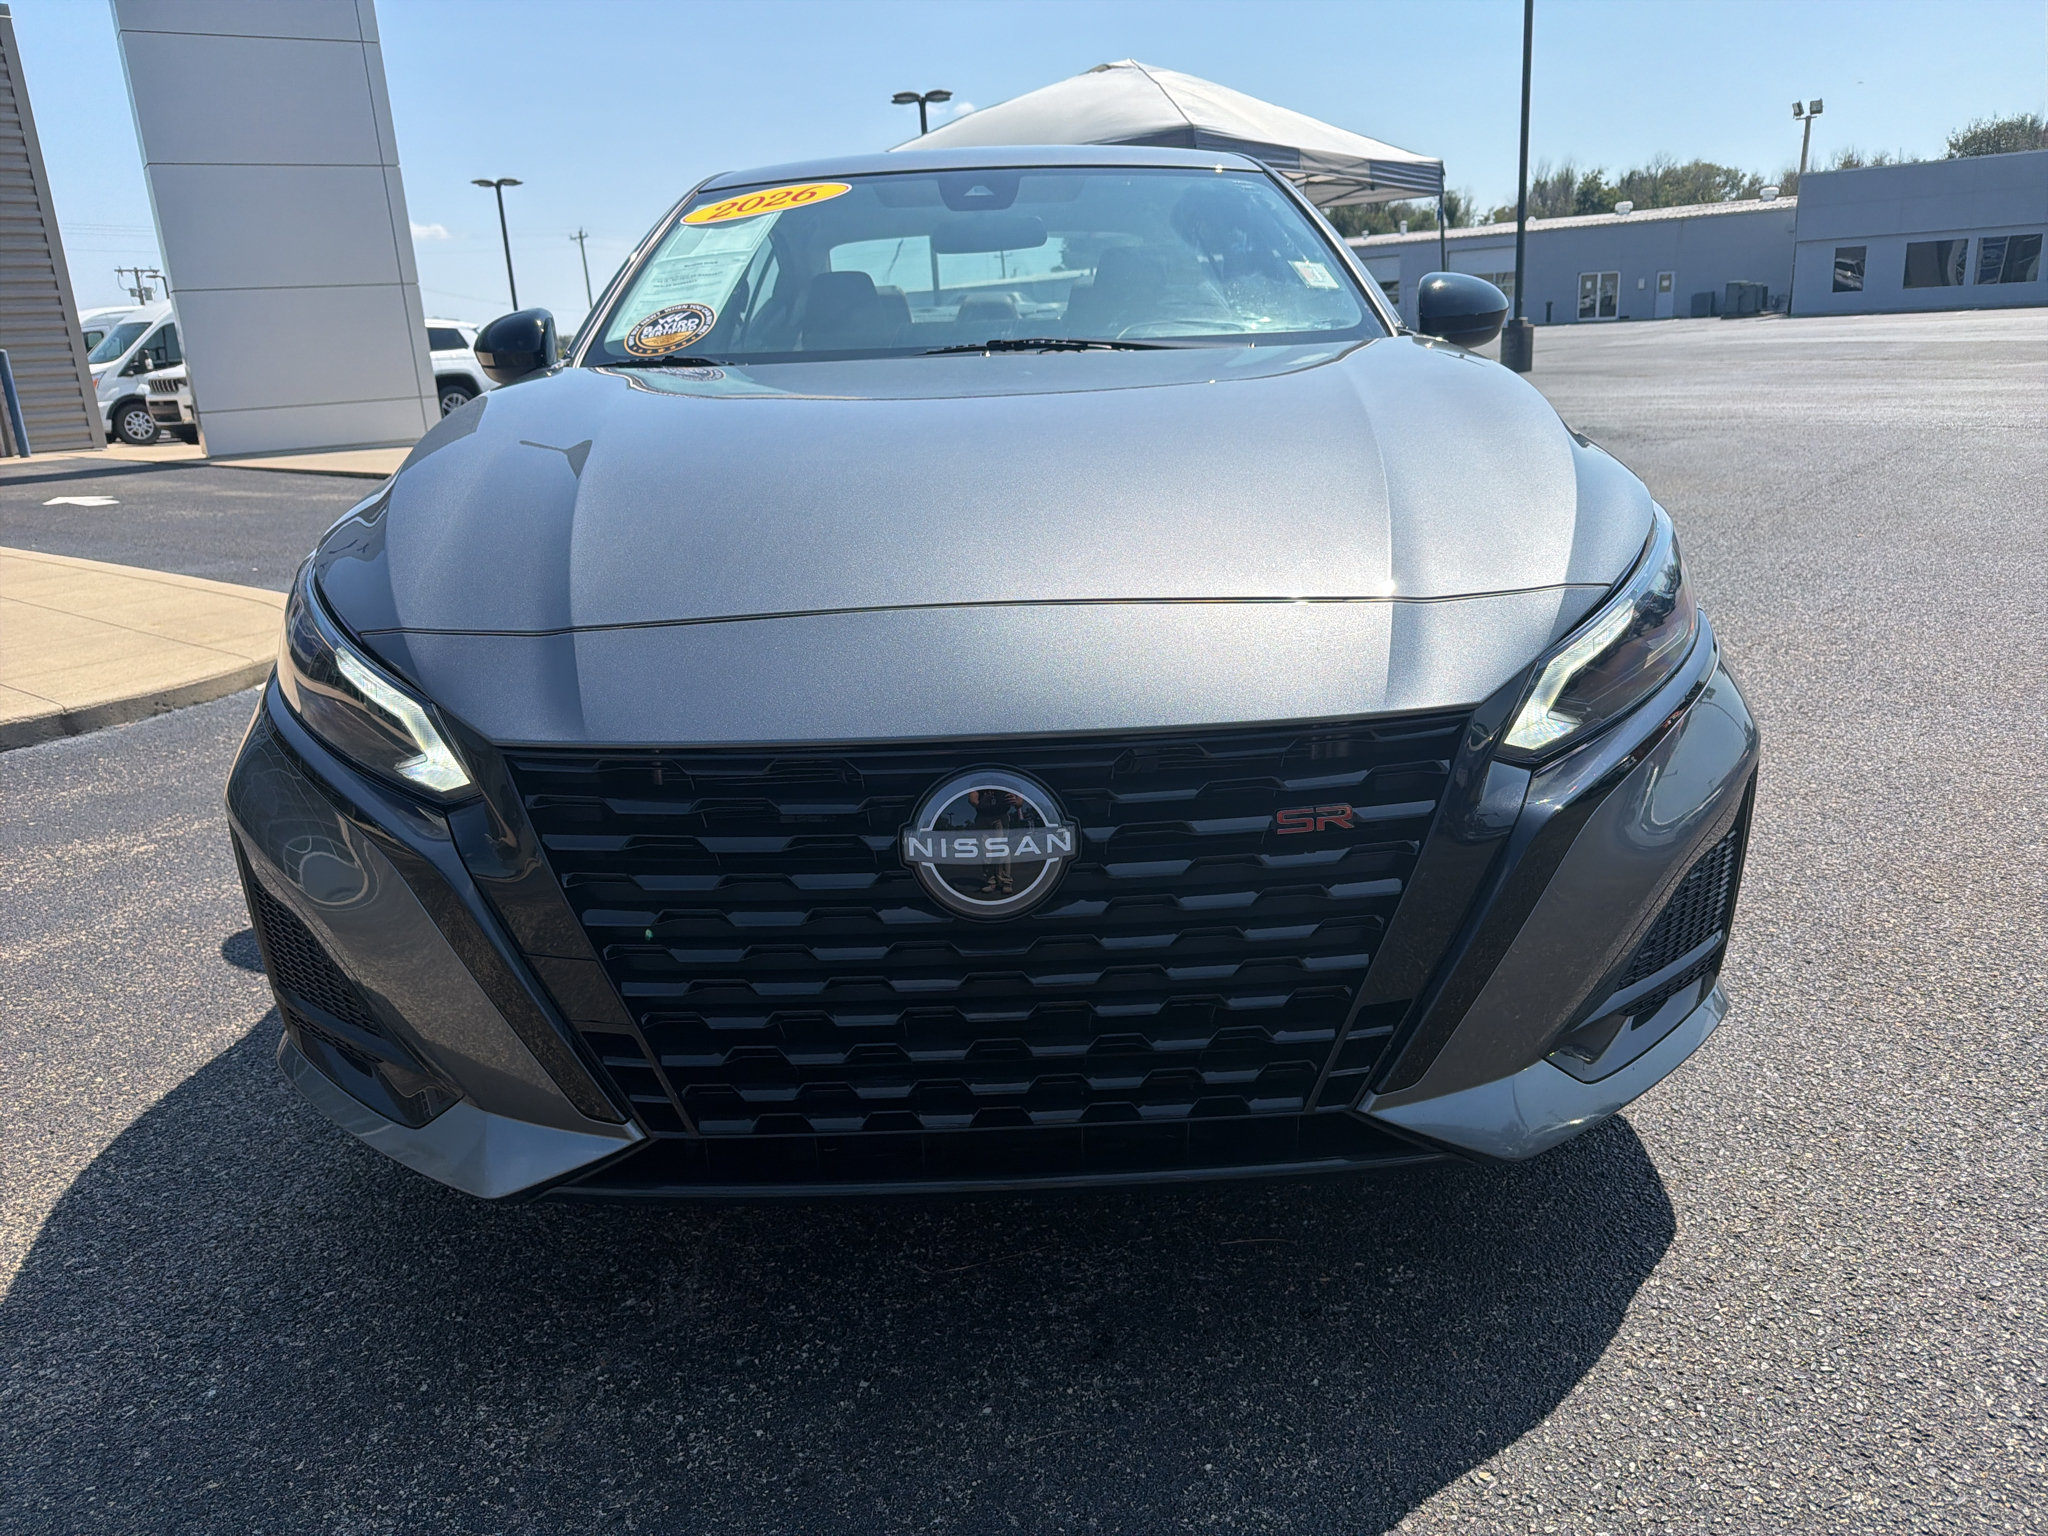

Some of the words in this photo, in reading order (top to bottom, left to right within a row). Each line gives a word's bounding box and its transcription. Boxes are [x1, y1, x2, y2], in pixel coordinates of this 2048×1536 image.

[707, 185, 824, 220] 2026
[643, 318, 699, 335] BAYIRD
[1277, 804, 1355, 835] SR
[908, 831, 1072, 858] NISSAN
